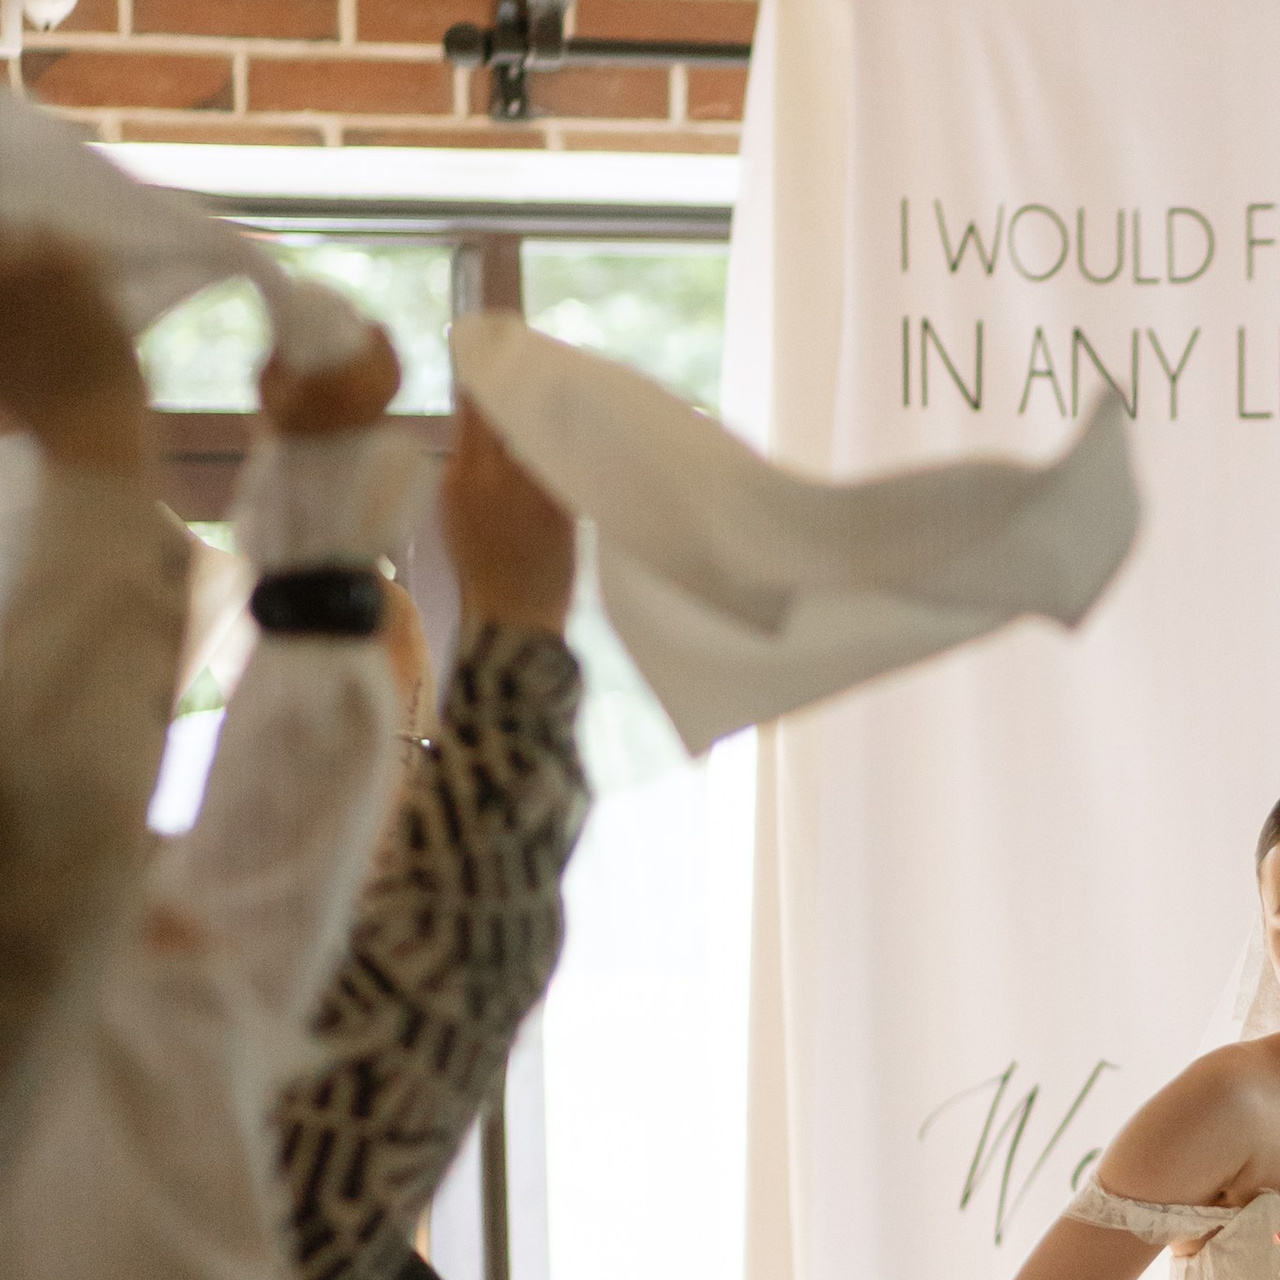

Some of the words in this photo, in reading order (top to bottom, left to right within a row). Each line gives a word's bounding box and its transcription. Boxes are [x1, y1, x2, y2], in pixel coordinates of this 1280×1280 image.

[899, 195, 910, 275] I
[933, 197, 1218, 287] WOULD
[900, 314, 986, 414] IN
[1017, 324, 1202, 422] ANY
